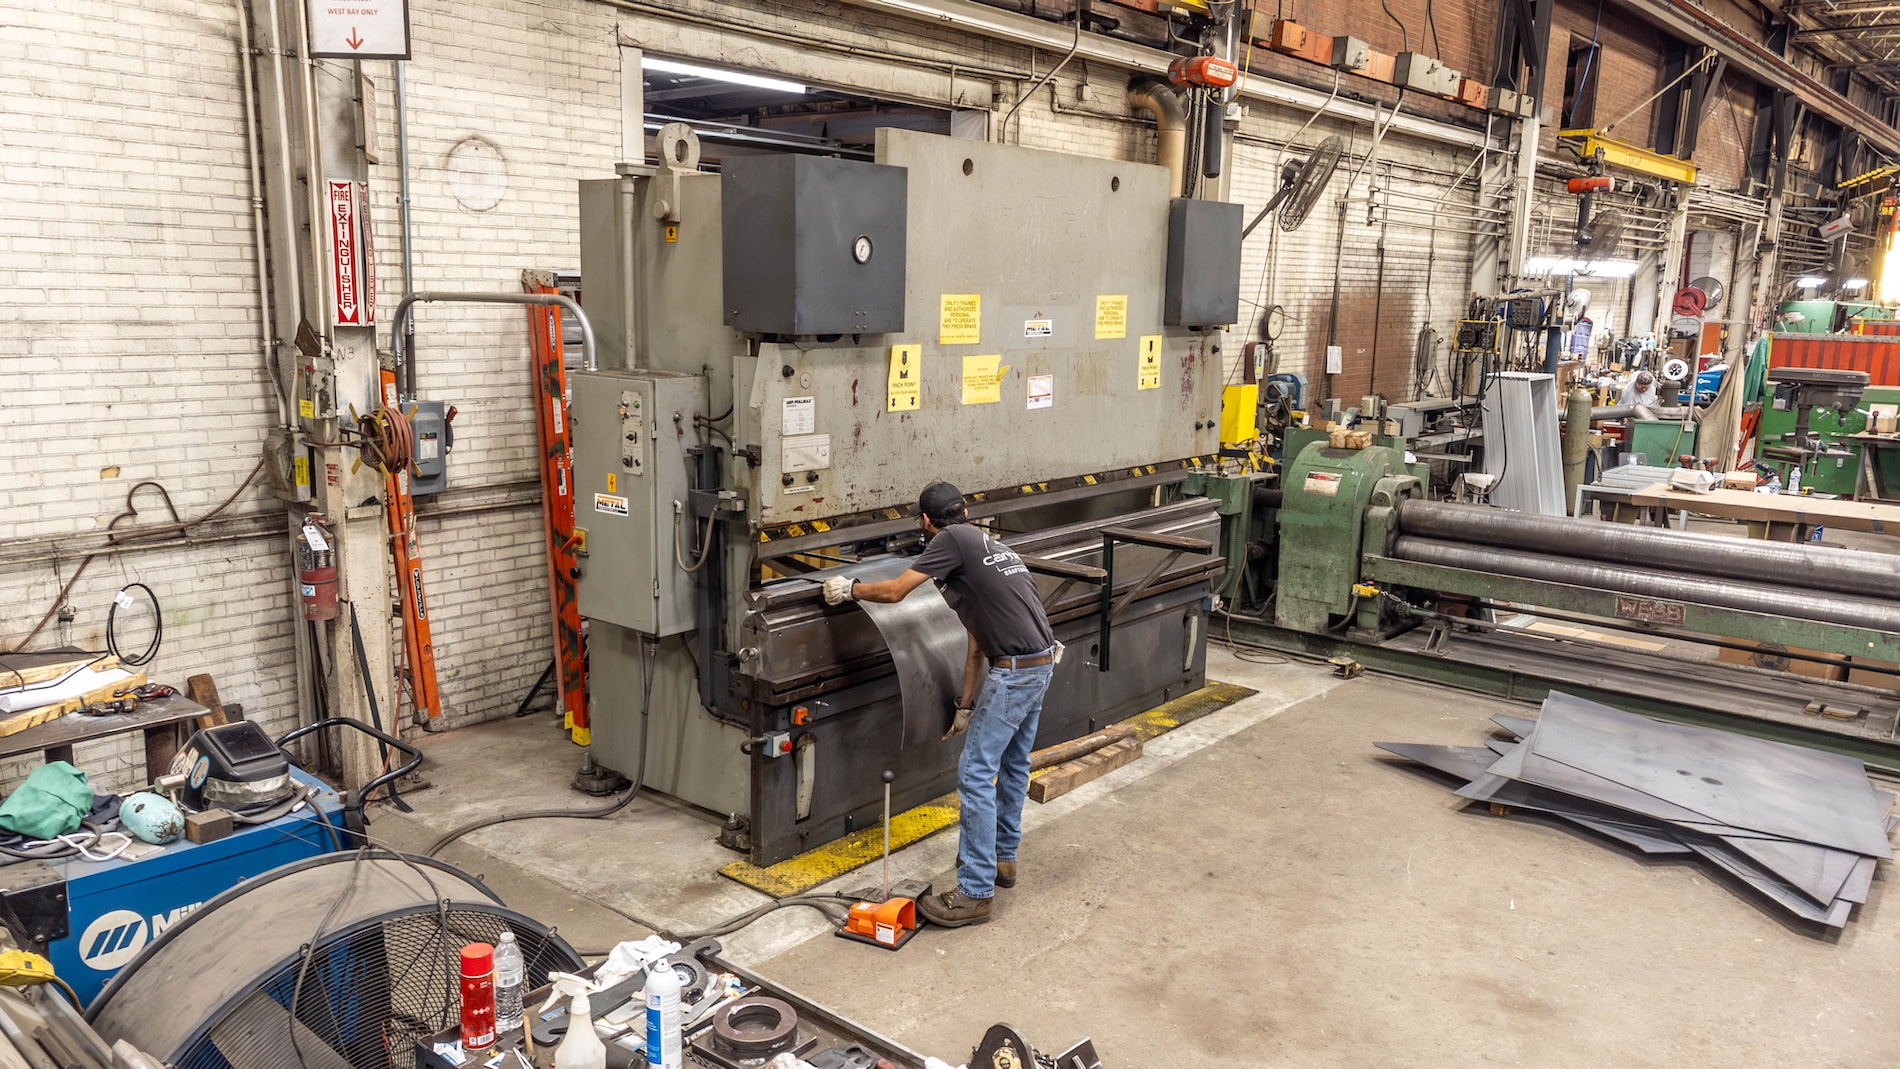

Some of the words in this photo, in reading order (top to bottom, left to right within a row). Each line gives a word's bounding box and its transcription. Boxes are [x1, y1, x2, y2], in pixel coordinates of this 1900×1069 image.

[333, 190, 350, 201] FIRE
[338, 204, 352, 309] EXTINGUISHER
[597, 498, 626, 509] METAL
[1620, 598, 1680, 620] WEBB
